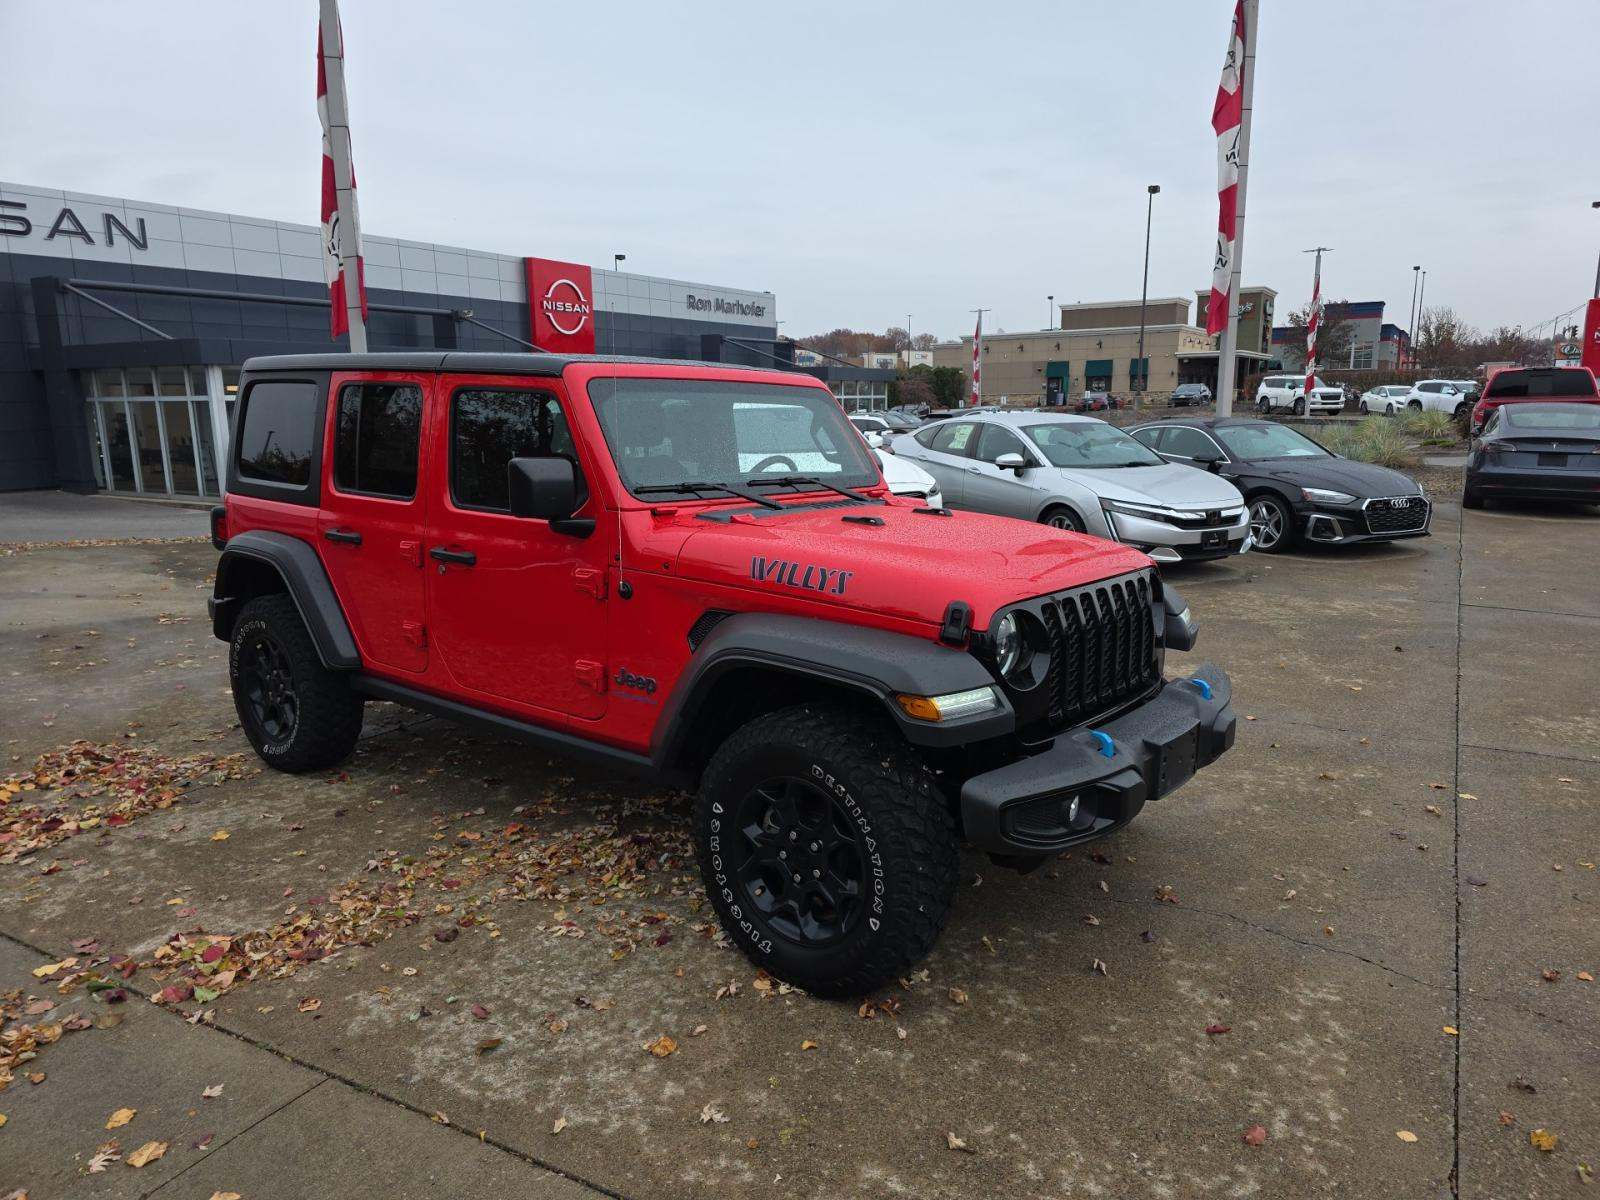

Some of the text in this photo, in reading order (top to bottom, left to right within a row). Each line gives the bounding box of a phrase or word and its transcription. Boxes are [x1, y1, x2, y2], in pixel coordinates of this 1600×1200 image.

[543, 300, 589, 314] NISSAN
[686, 294, 712, 313] Ron
[751, 556, 853, 595] WILLYS
[614, 667, 657, 694] Jeep
[811, 764, 885, 914] DESTINATION
